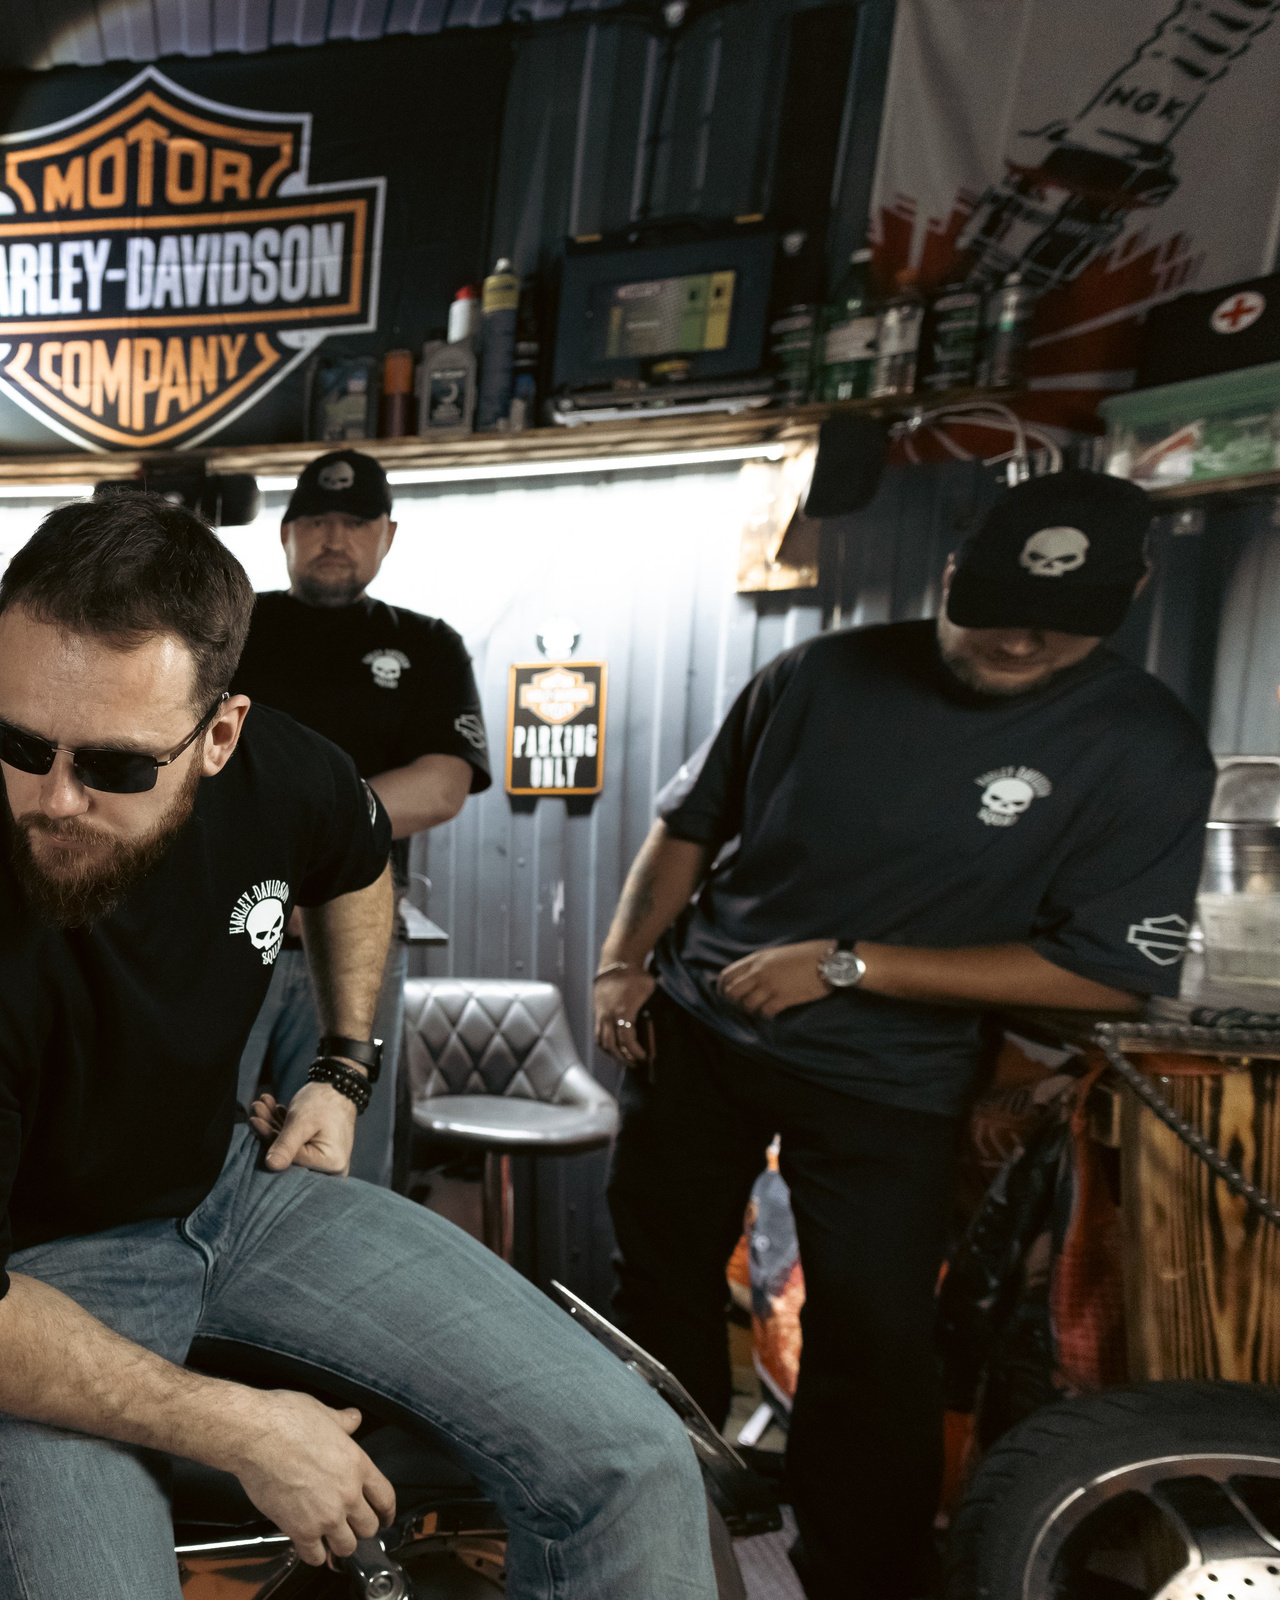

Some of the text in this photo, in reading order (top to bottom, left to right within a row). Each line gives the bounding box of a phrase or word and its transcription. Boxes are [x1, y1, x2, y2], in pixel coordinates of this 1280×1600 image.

[43, 118, 252, 212] MOTOR
[38, 334, 248, 431] COMPANY
[513, 723, 598, 759] PARKING
[529, 756, 579, 789] ONLY
